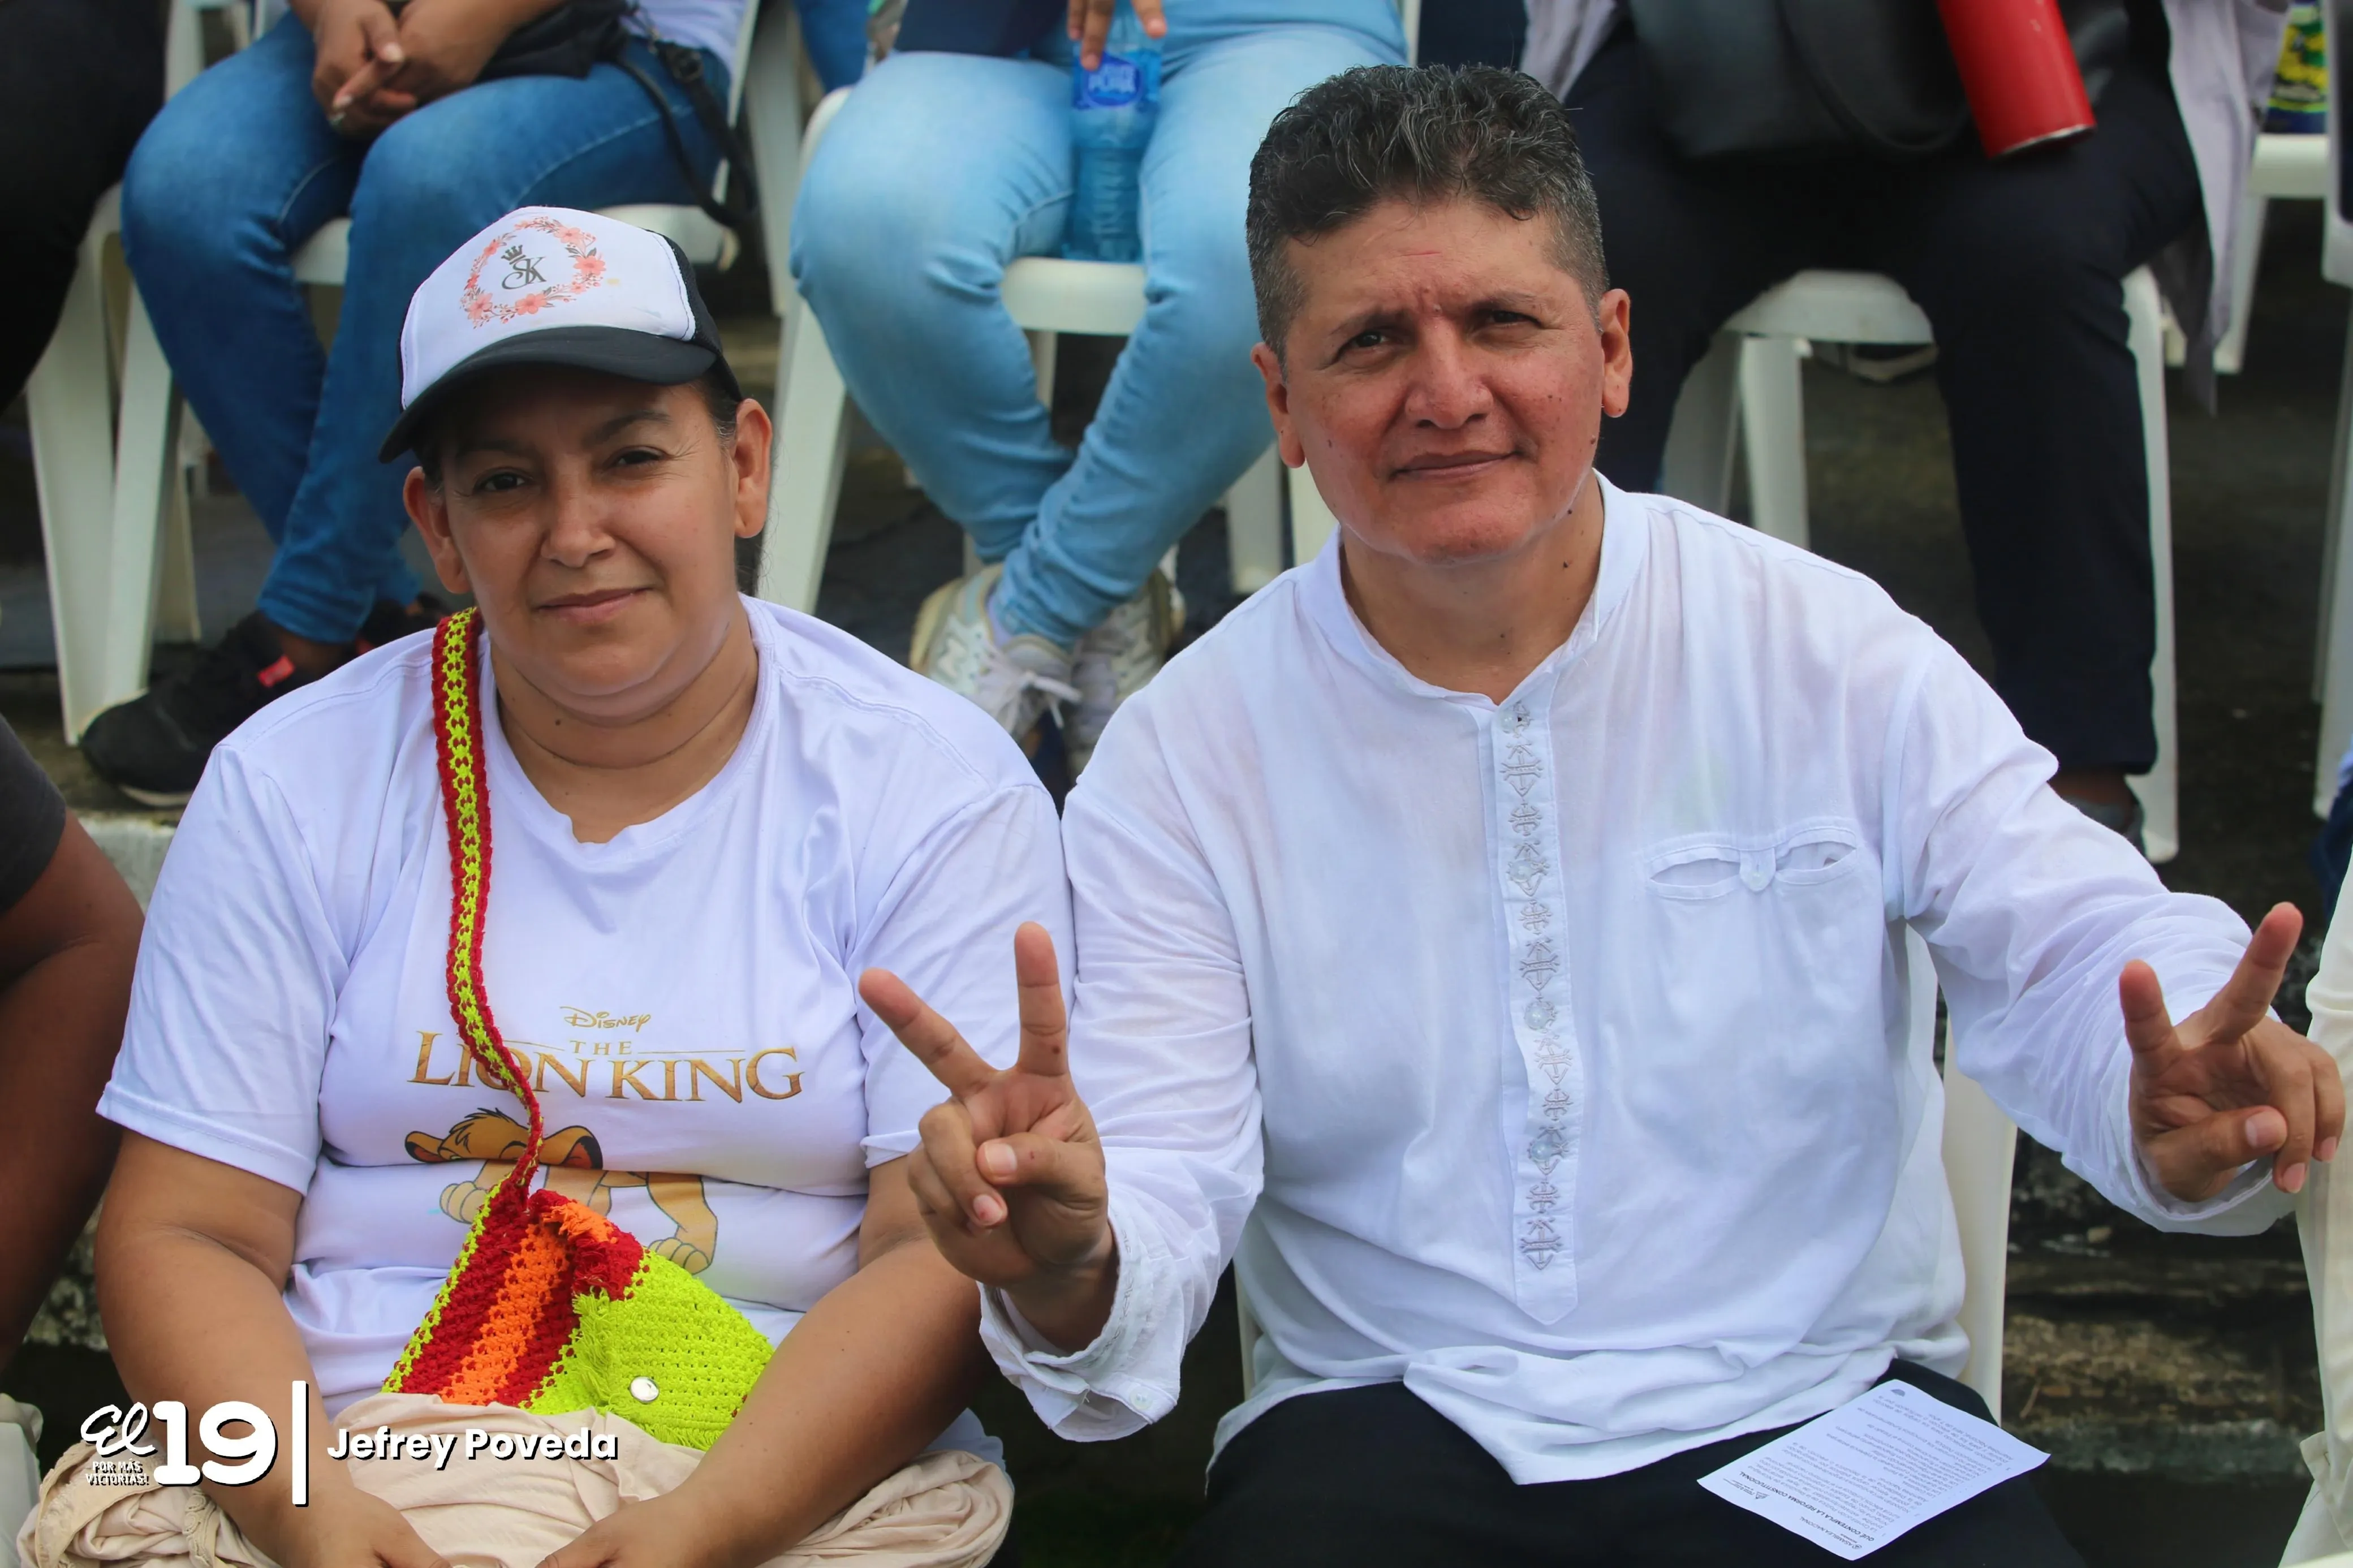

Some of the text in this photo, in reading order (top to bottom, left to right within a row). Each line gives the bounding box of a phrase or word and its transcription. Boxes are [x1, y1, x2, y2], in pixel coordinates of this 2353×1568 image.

[570, 1040, 632, 1056] THE
[407, 1031, 804, 1103] LION KING
[1740, 1472, 1788, 1497] CONSTITUCIONAL
[1788, 1496, 1817, 1511] REFORMA
[1801, 1517, 1825, 1531] NACIONAL
[1825, 1514, 1861, 1535] CONTEMPLA
[1825, 1530, 1853, 1545] ASAMBLEA
